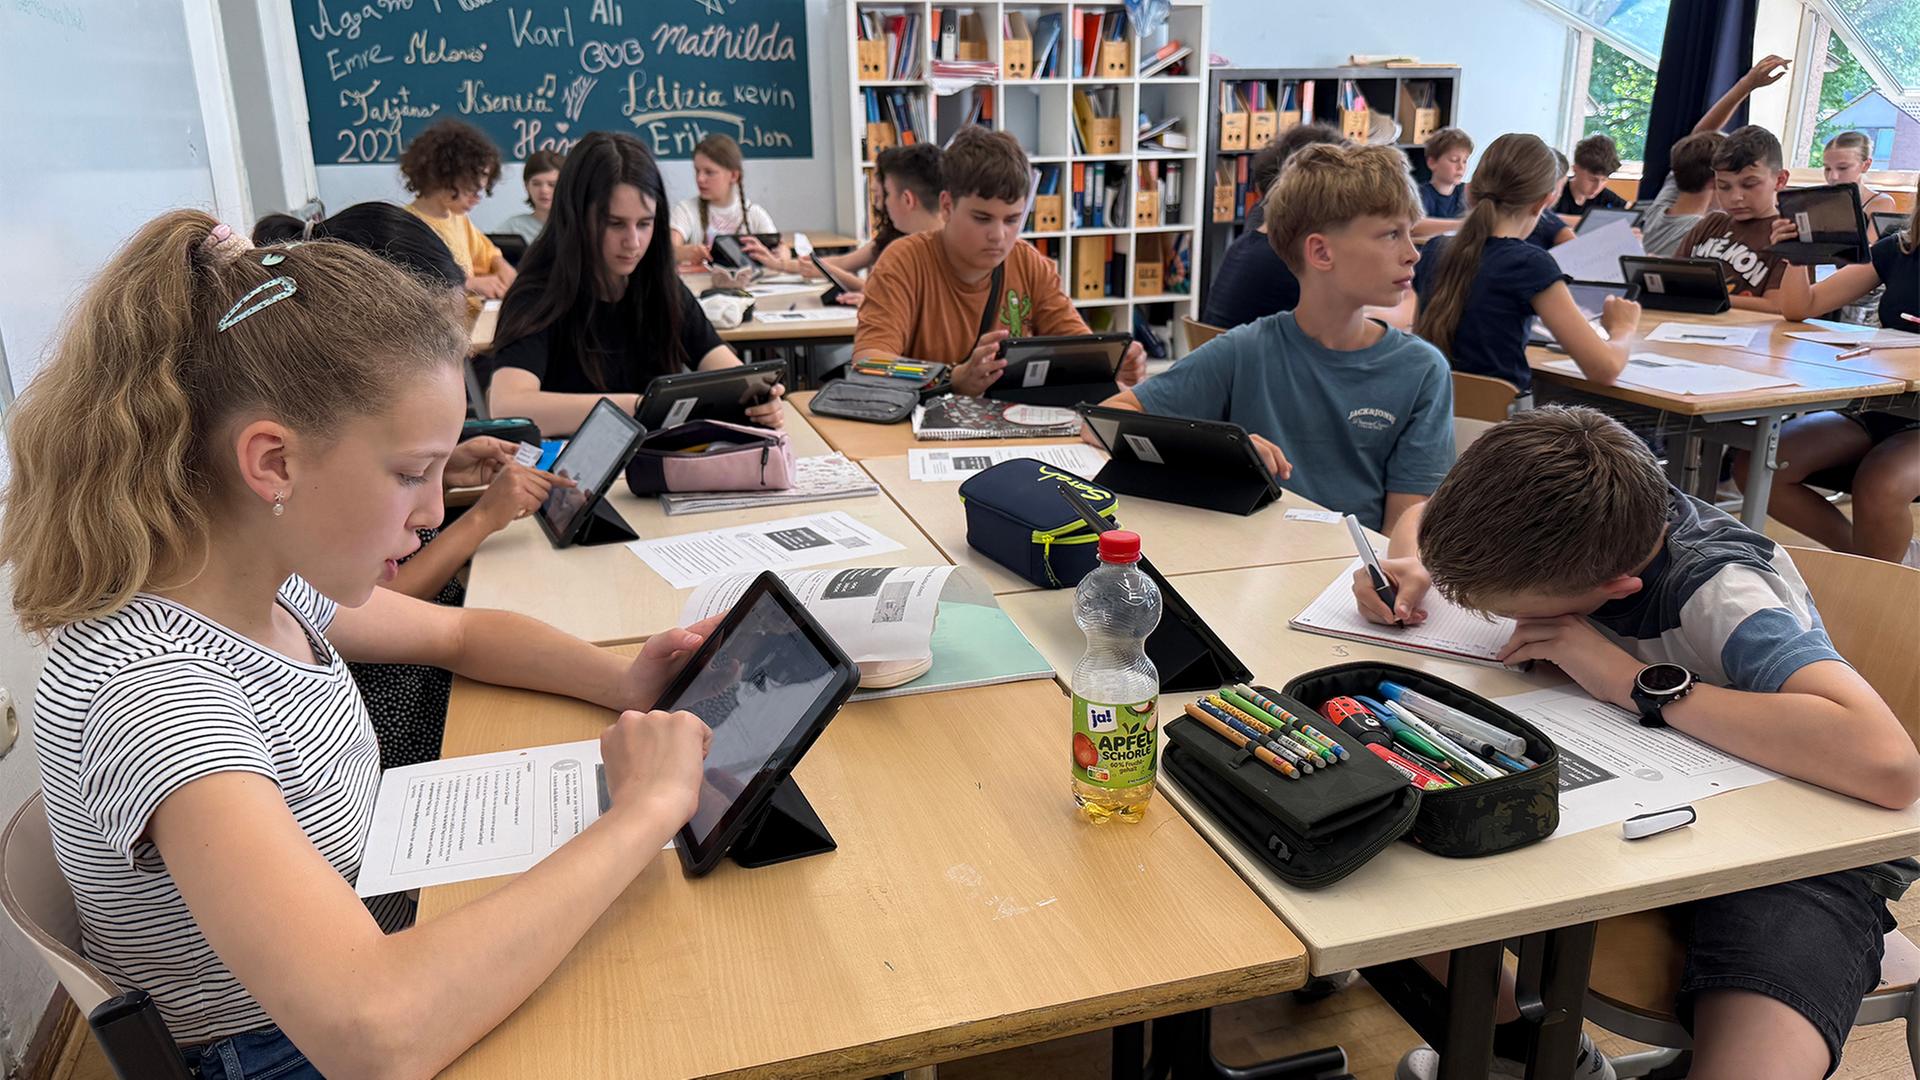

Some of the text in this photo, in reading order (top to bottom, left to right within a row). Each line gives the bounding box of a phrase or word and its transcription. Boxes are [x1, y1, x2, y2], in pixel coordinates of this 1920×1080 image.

[507, 7, 574, 48] Karl
[652, 21, 796, 61] Mathilda
[327, 44, 394, 81] Emre
[340, 80, 440, 135] Tatjana
[619, 70, 728, 116] Letizia
[1091, 709, 1112, 728] ja!
[1098, 731, 1154, 751] APFEL
[1102, 745, 1152, 761] SCHORLE
